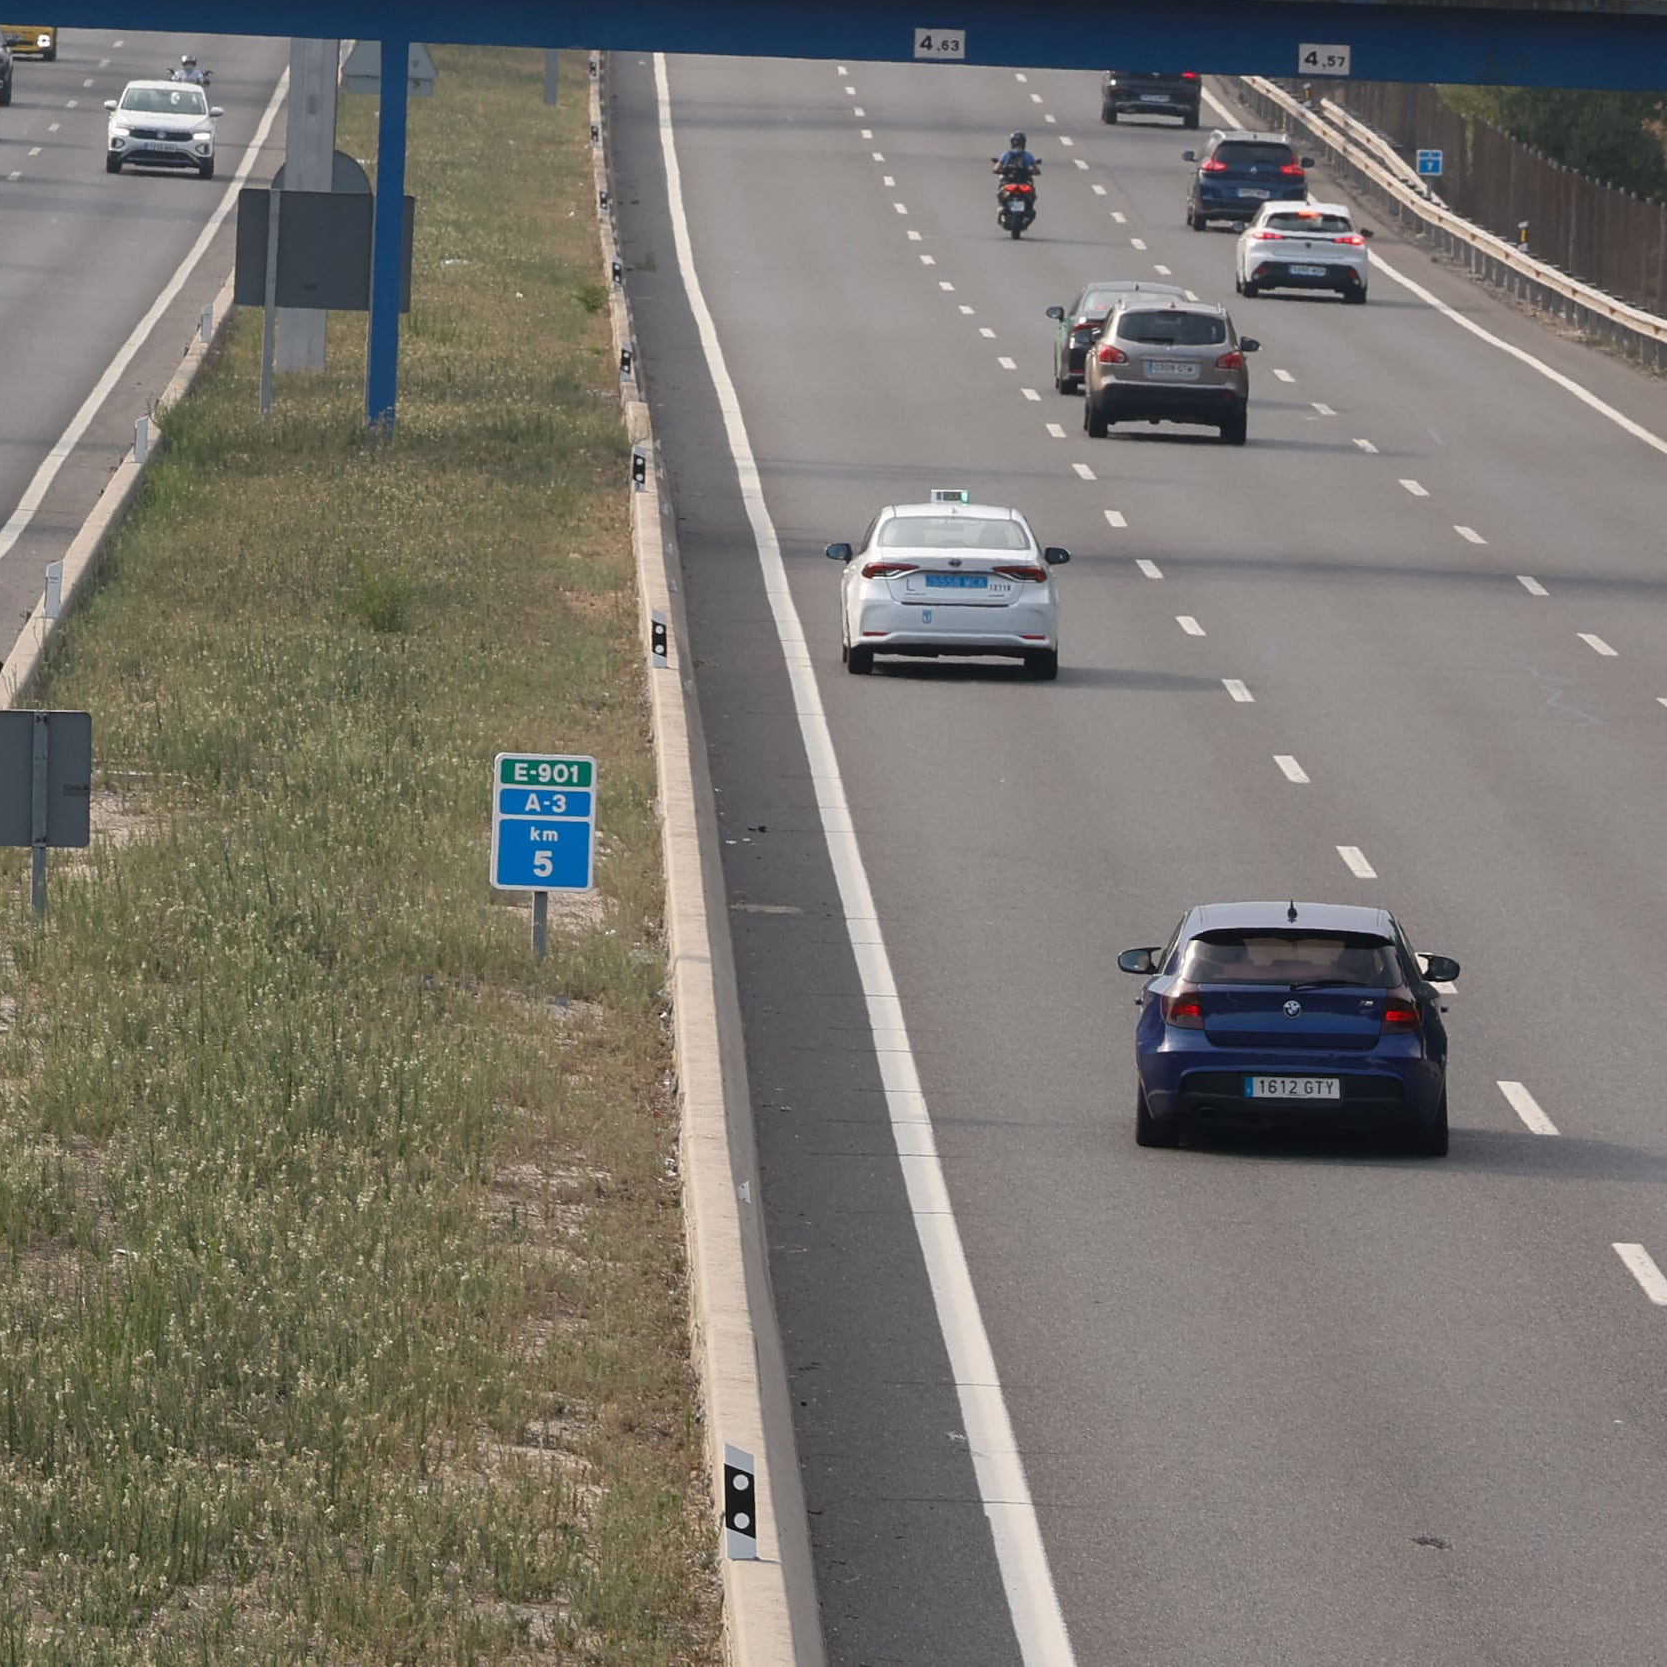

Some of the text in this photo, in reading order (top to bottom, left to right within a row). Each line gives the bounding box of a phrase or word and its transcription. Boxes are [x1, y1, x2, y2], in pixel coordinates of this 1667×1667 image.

[919, 34, 960, 52] 4,63
[1304, 50, 1346, 69] 4,57
[514, 762, 579, 783] E-901
[524, 793, 567, 813] A-3
[529, 826, 559, 842] km
[533, 850, 553, 877] 5
[1259, 1079, 1334, 1095] 1612 GTY
